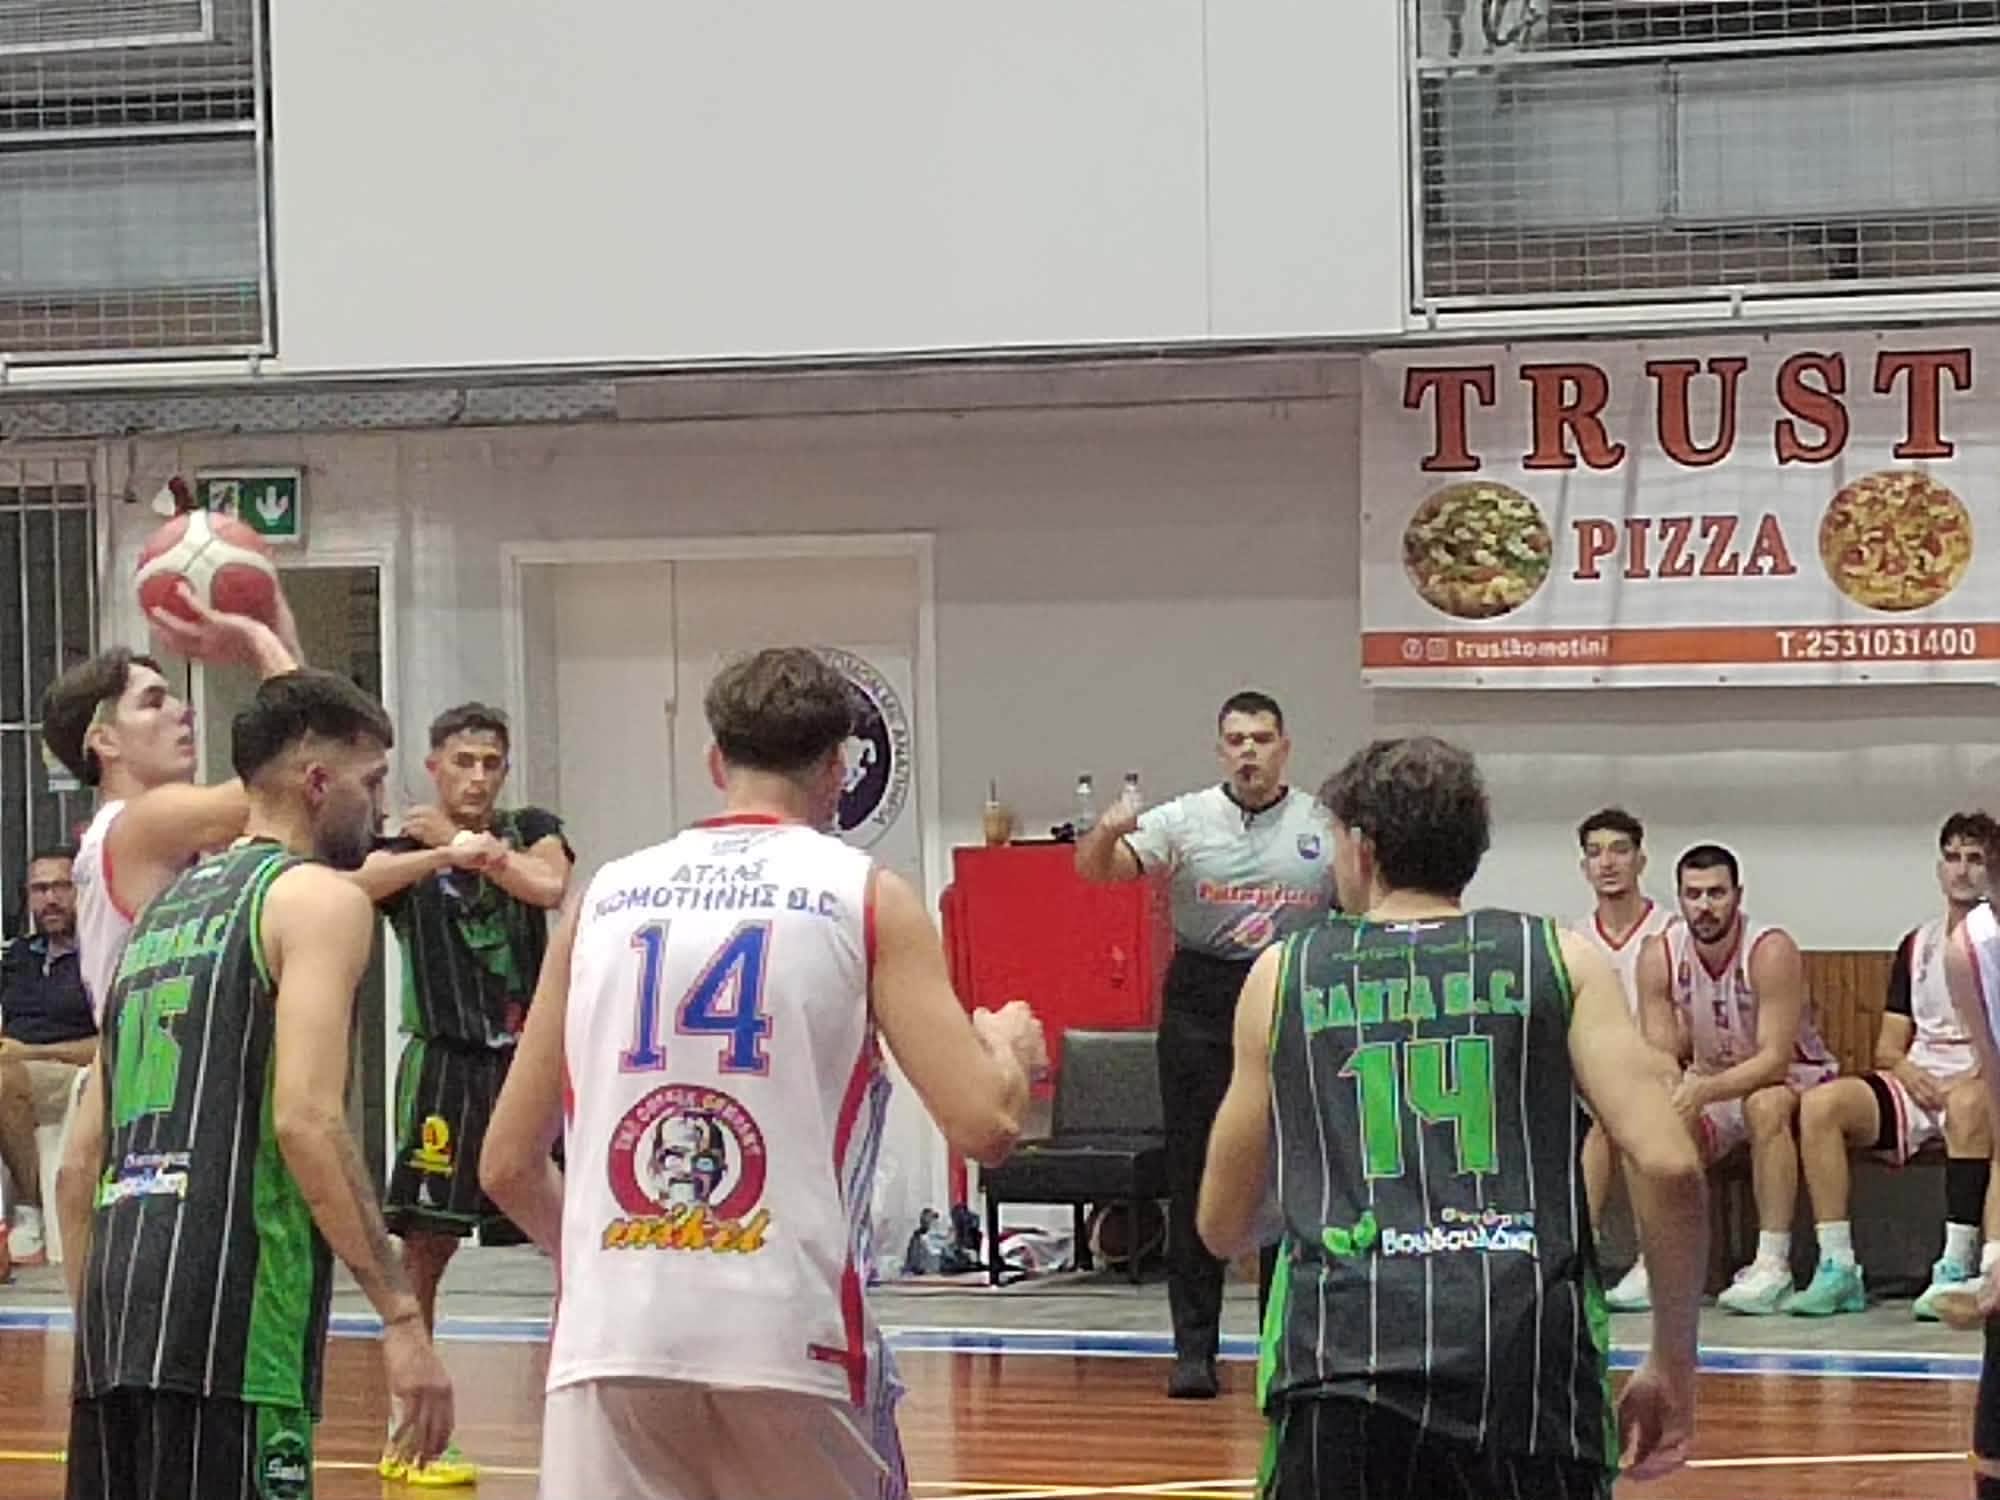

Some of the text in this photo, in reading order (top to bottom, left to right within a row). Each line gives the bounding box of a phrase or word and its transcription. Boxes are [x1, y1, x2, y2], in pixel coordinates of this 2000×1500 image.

[1404, 349, 1972, 472] TRUST
[1573, 514, 1797, 579] PIZZA
[1776, 628, 1976, 659] T.2531031400
[618, 919, 773, 1076] 14
[1337, 1035, 1498, 1178] 14
